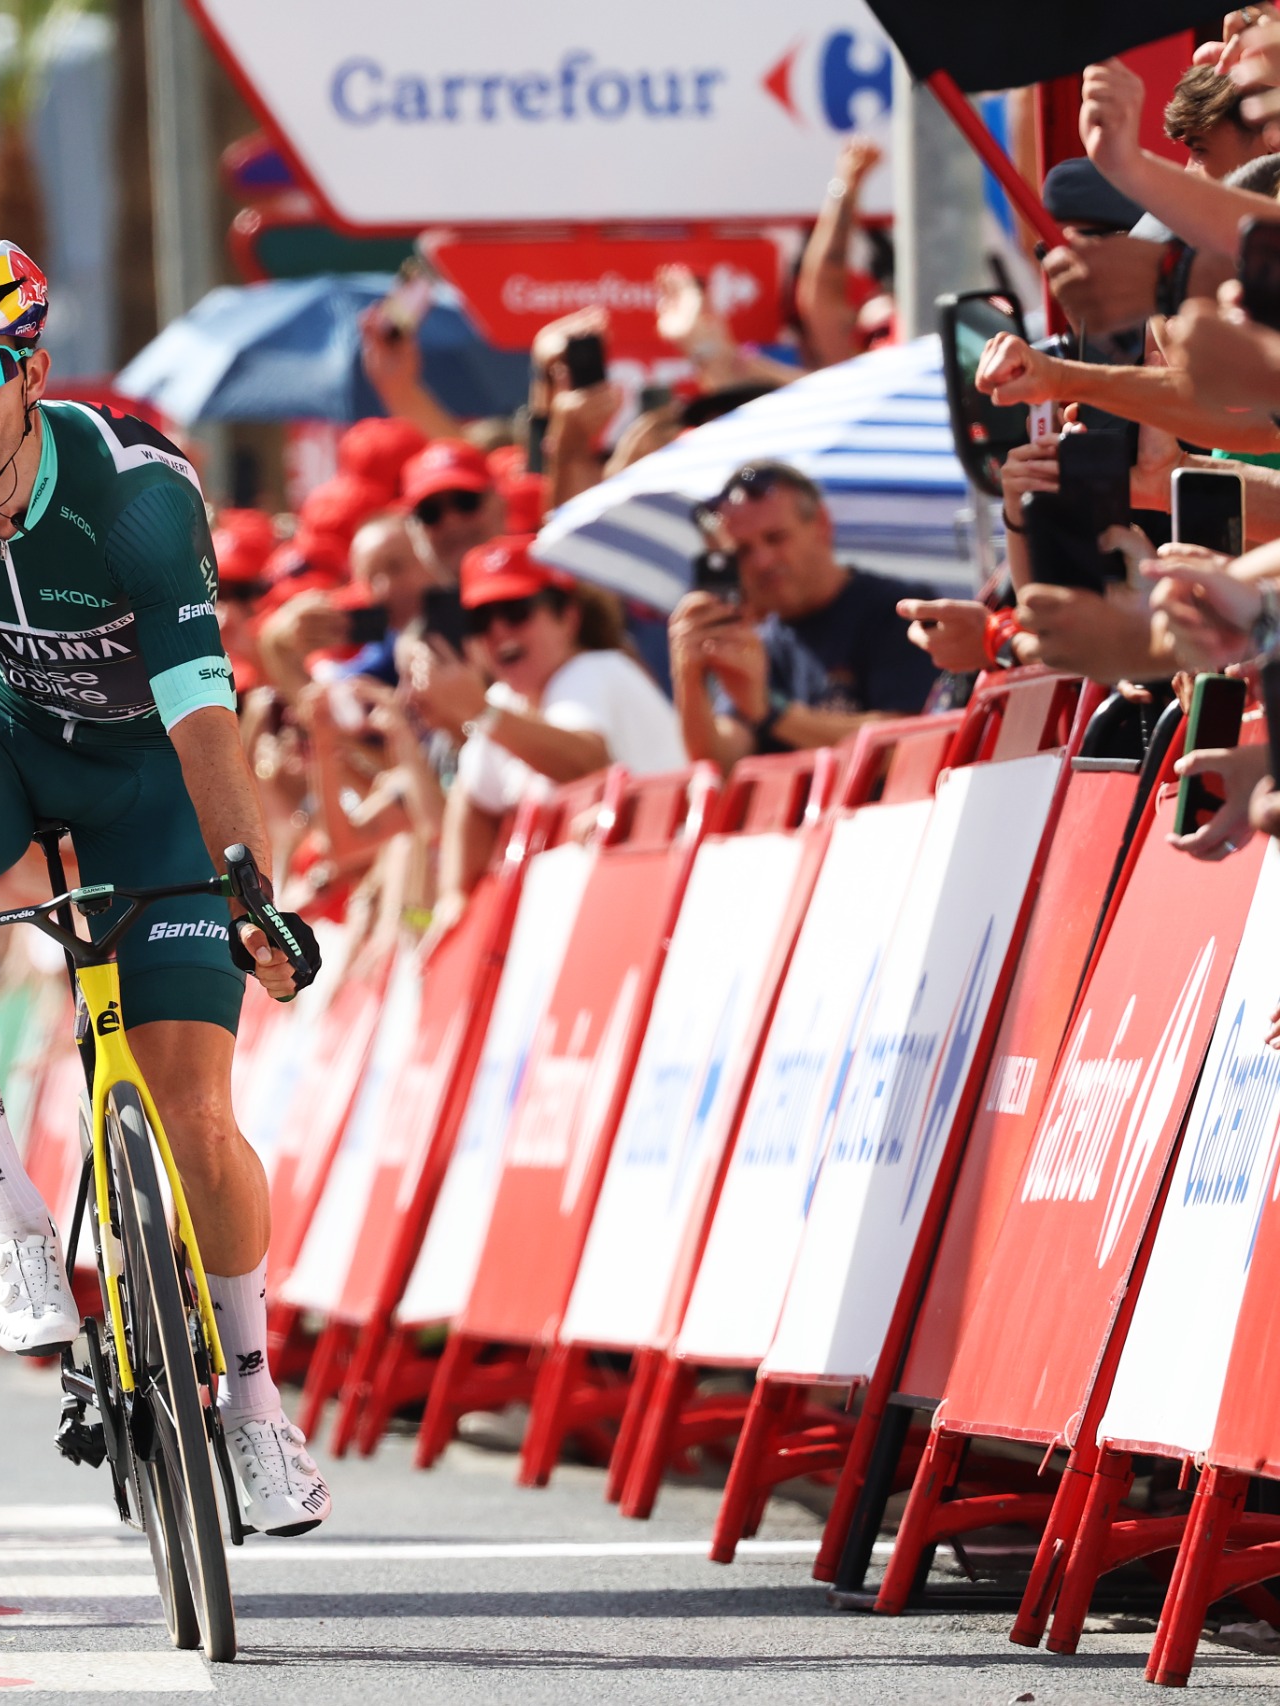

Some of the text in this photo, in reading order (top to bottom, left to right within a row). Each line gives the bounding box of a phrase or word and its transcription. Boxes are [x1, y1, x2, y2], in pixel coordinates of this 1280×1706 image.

[331, 49, 724, 126] Carrefour
[502, 271, 661, 315] Carrefou
[15, 321, 37, 335] GIRO
[1, 632, 132, 661] VISMA
[75, 629, 102, 639] VAN
[104, 614, 135, 634] AERT
[82, 886, 107, 895] GARMIN
[261, 903, 302, 957] SRAM
[832, 970, 938, 1165] arrefour
[1021, 993, 1143, 1204] Carrefour
